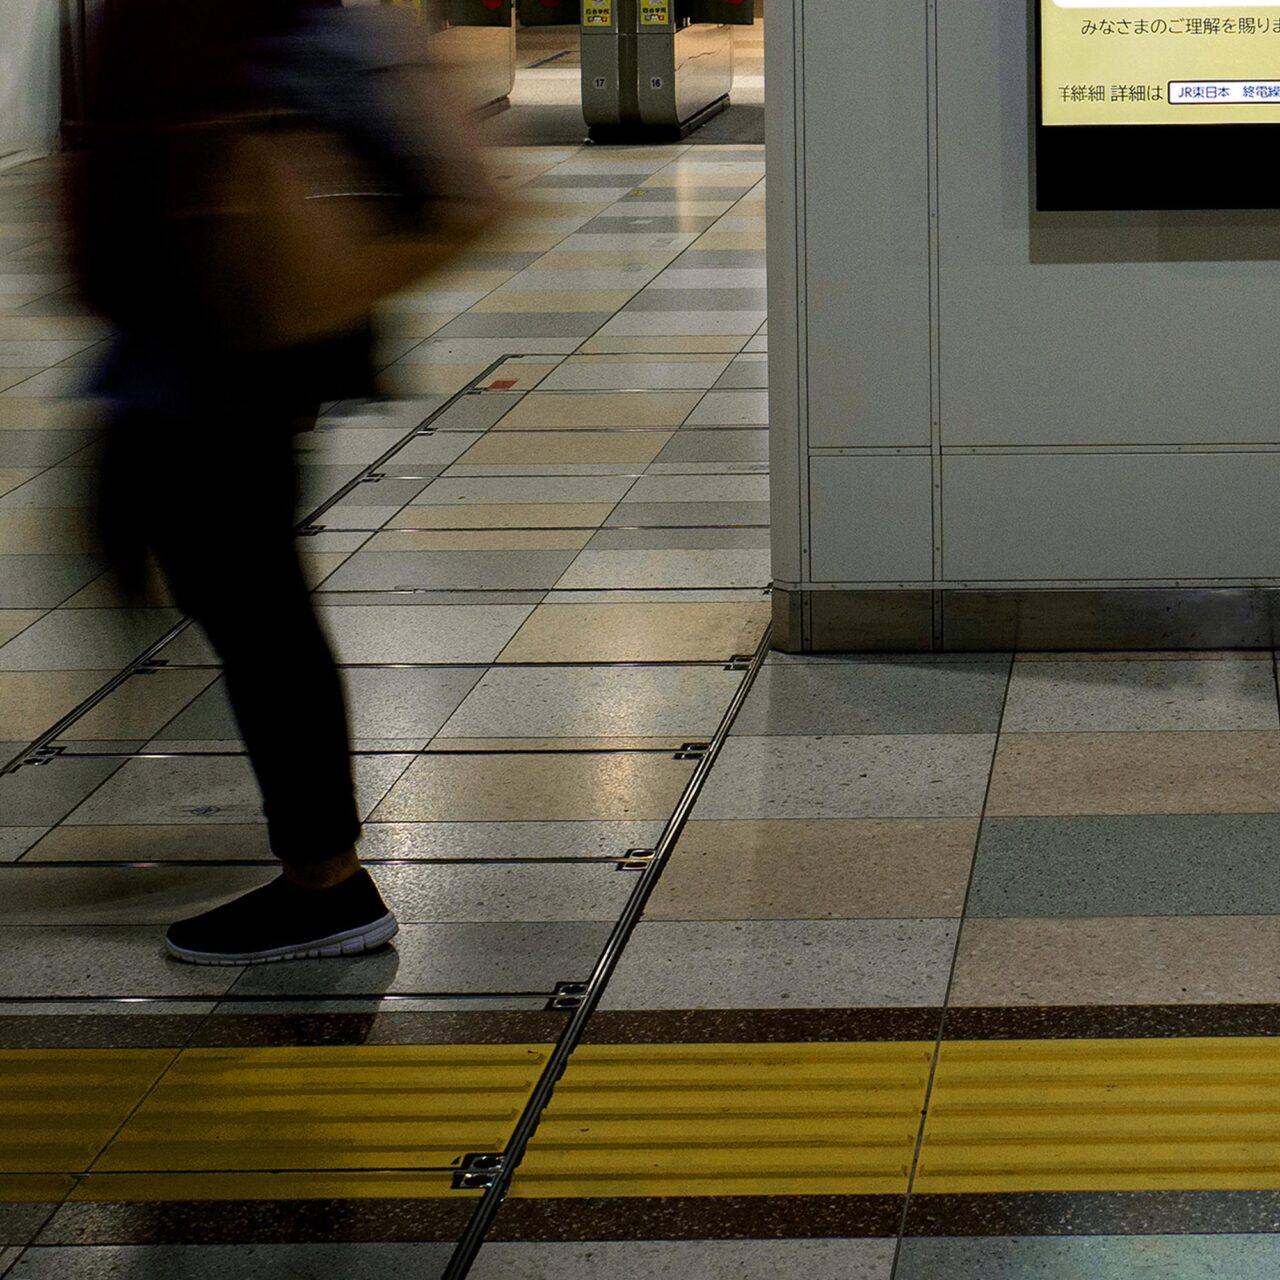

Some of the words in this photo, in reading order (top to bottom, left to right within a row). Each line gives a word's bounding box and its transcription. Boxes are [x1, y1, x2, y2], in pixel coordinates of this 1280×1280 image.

[1111, 85, 1163, 101] 詳細は
[1178, 86, 1230, 99] JR東日本
